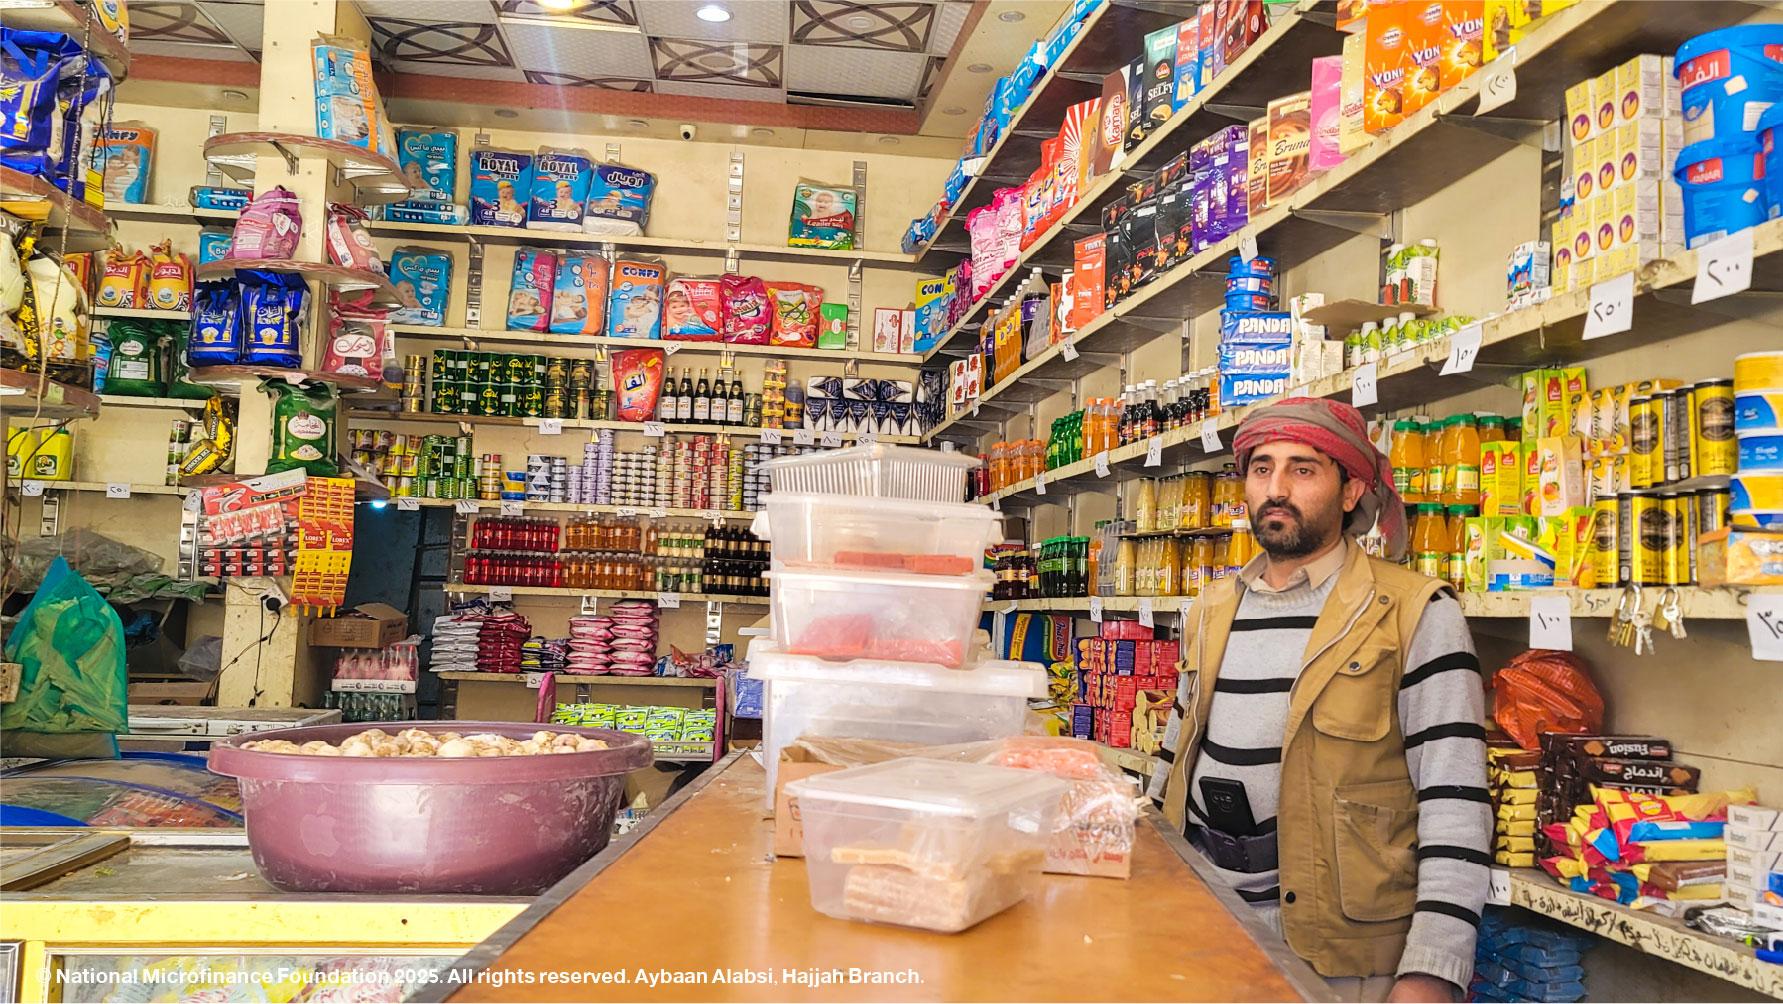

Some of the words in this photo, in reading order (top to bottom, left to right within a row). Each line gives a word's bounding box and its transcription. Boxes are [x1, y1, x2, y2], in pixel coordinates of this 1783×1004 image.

[1147, 82, 1175, 101] SELFY
[480, 158, 520, 173] ROYAL
[539, 160, 579, 175] ROYAL
[1707, 259, 1740, 285] ٢٠٠
[1239, 317, 1291, 334] PANDA
[1236, 350, 1287, 366] PANDA
[1233, 378, 1284, 396] PANDA
[1538, 612, 1560, 630] ١٠٠
[1609, 743, 1649, 755] Fusion
